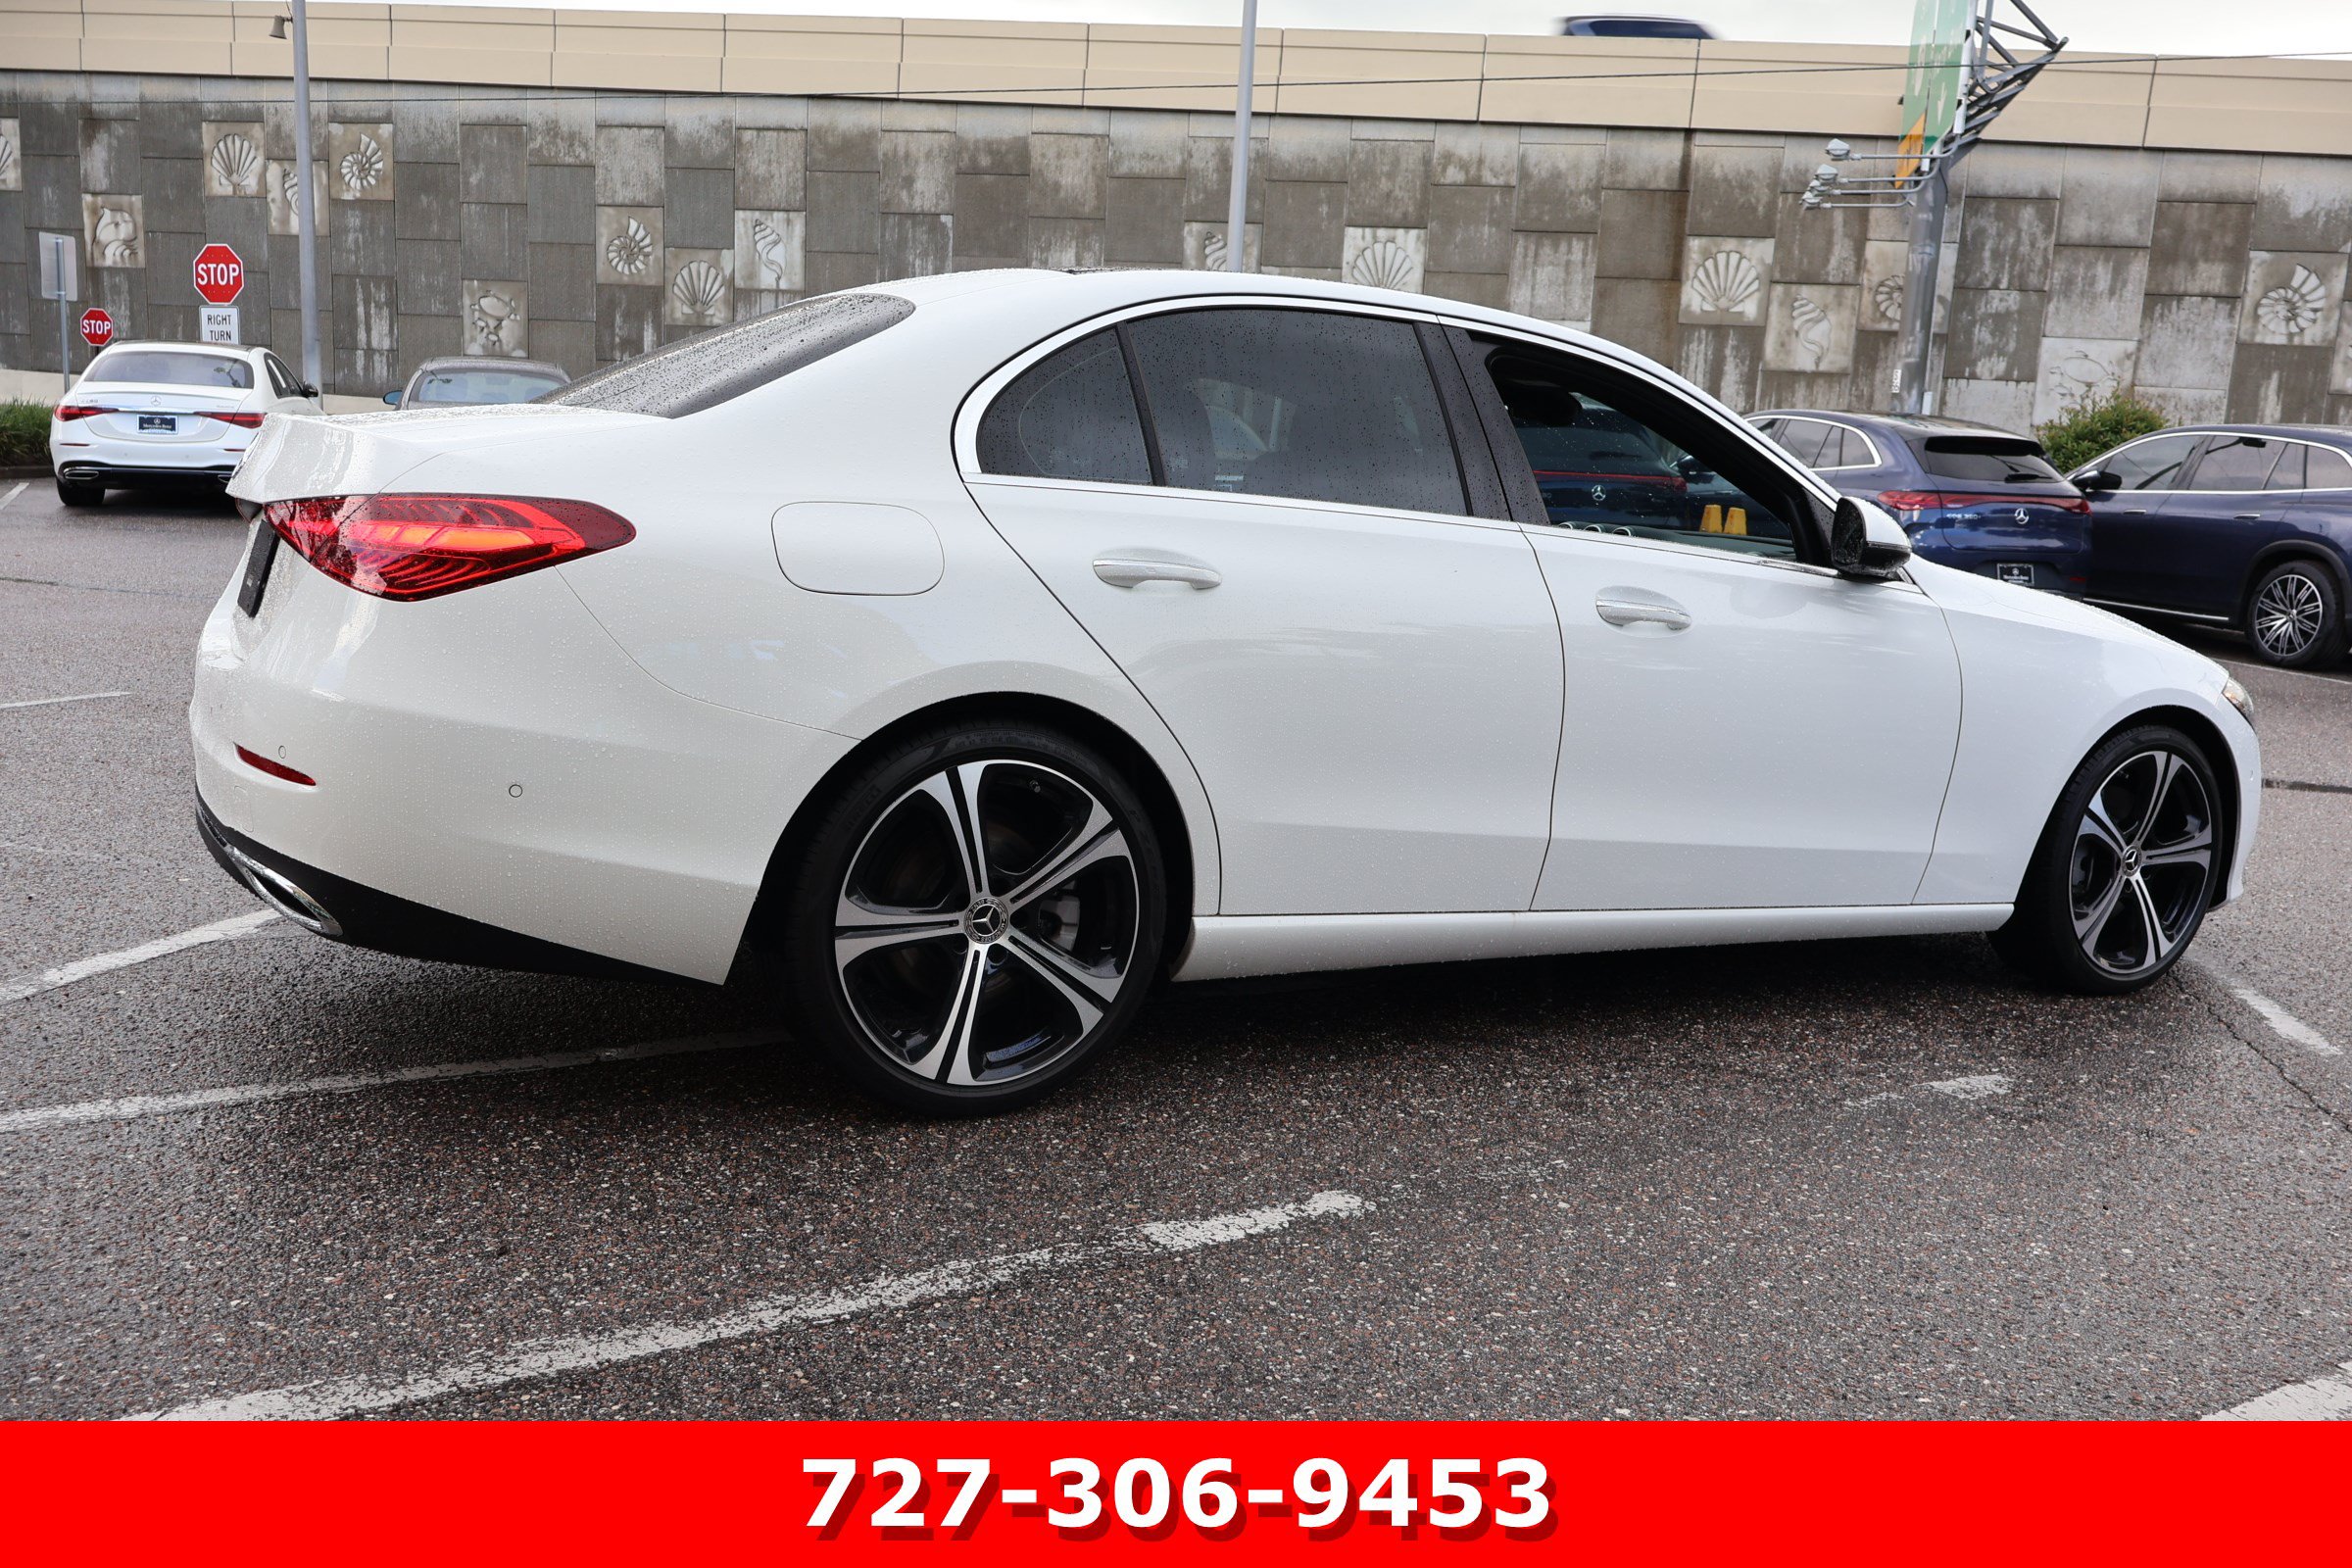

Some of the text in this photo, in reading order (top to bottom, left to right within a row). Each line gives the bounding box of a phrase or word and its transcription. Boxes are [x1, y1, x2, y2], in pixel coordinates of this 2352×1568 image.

[197, 263, 240, 286] STOP
[82, 318, 112, 335] STOP
[207, 314, 231, 325] RIGHT
[210, 329, 231, 341] TURN
